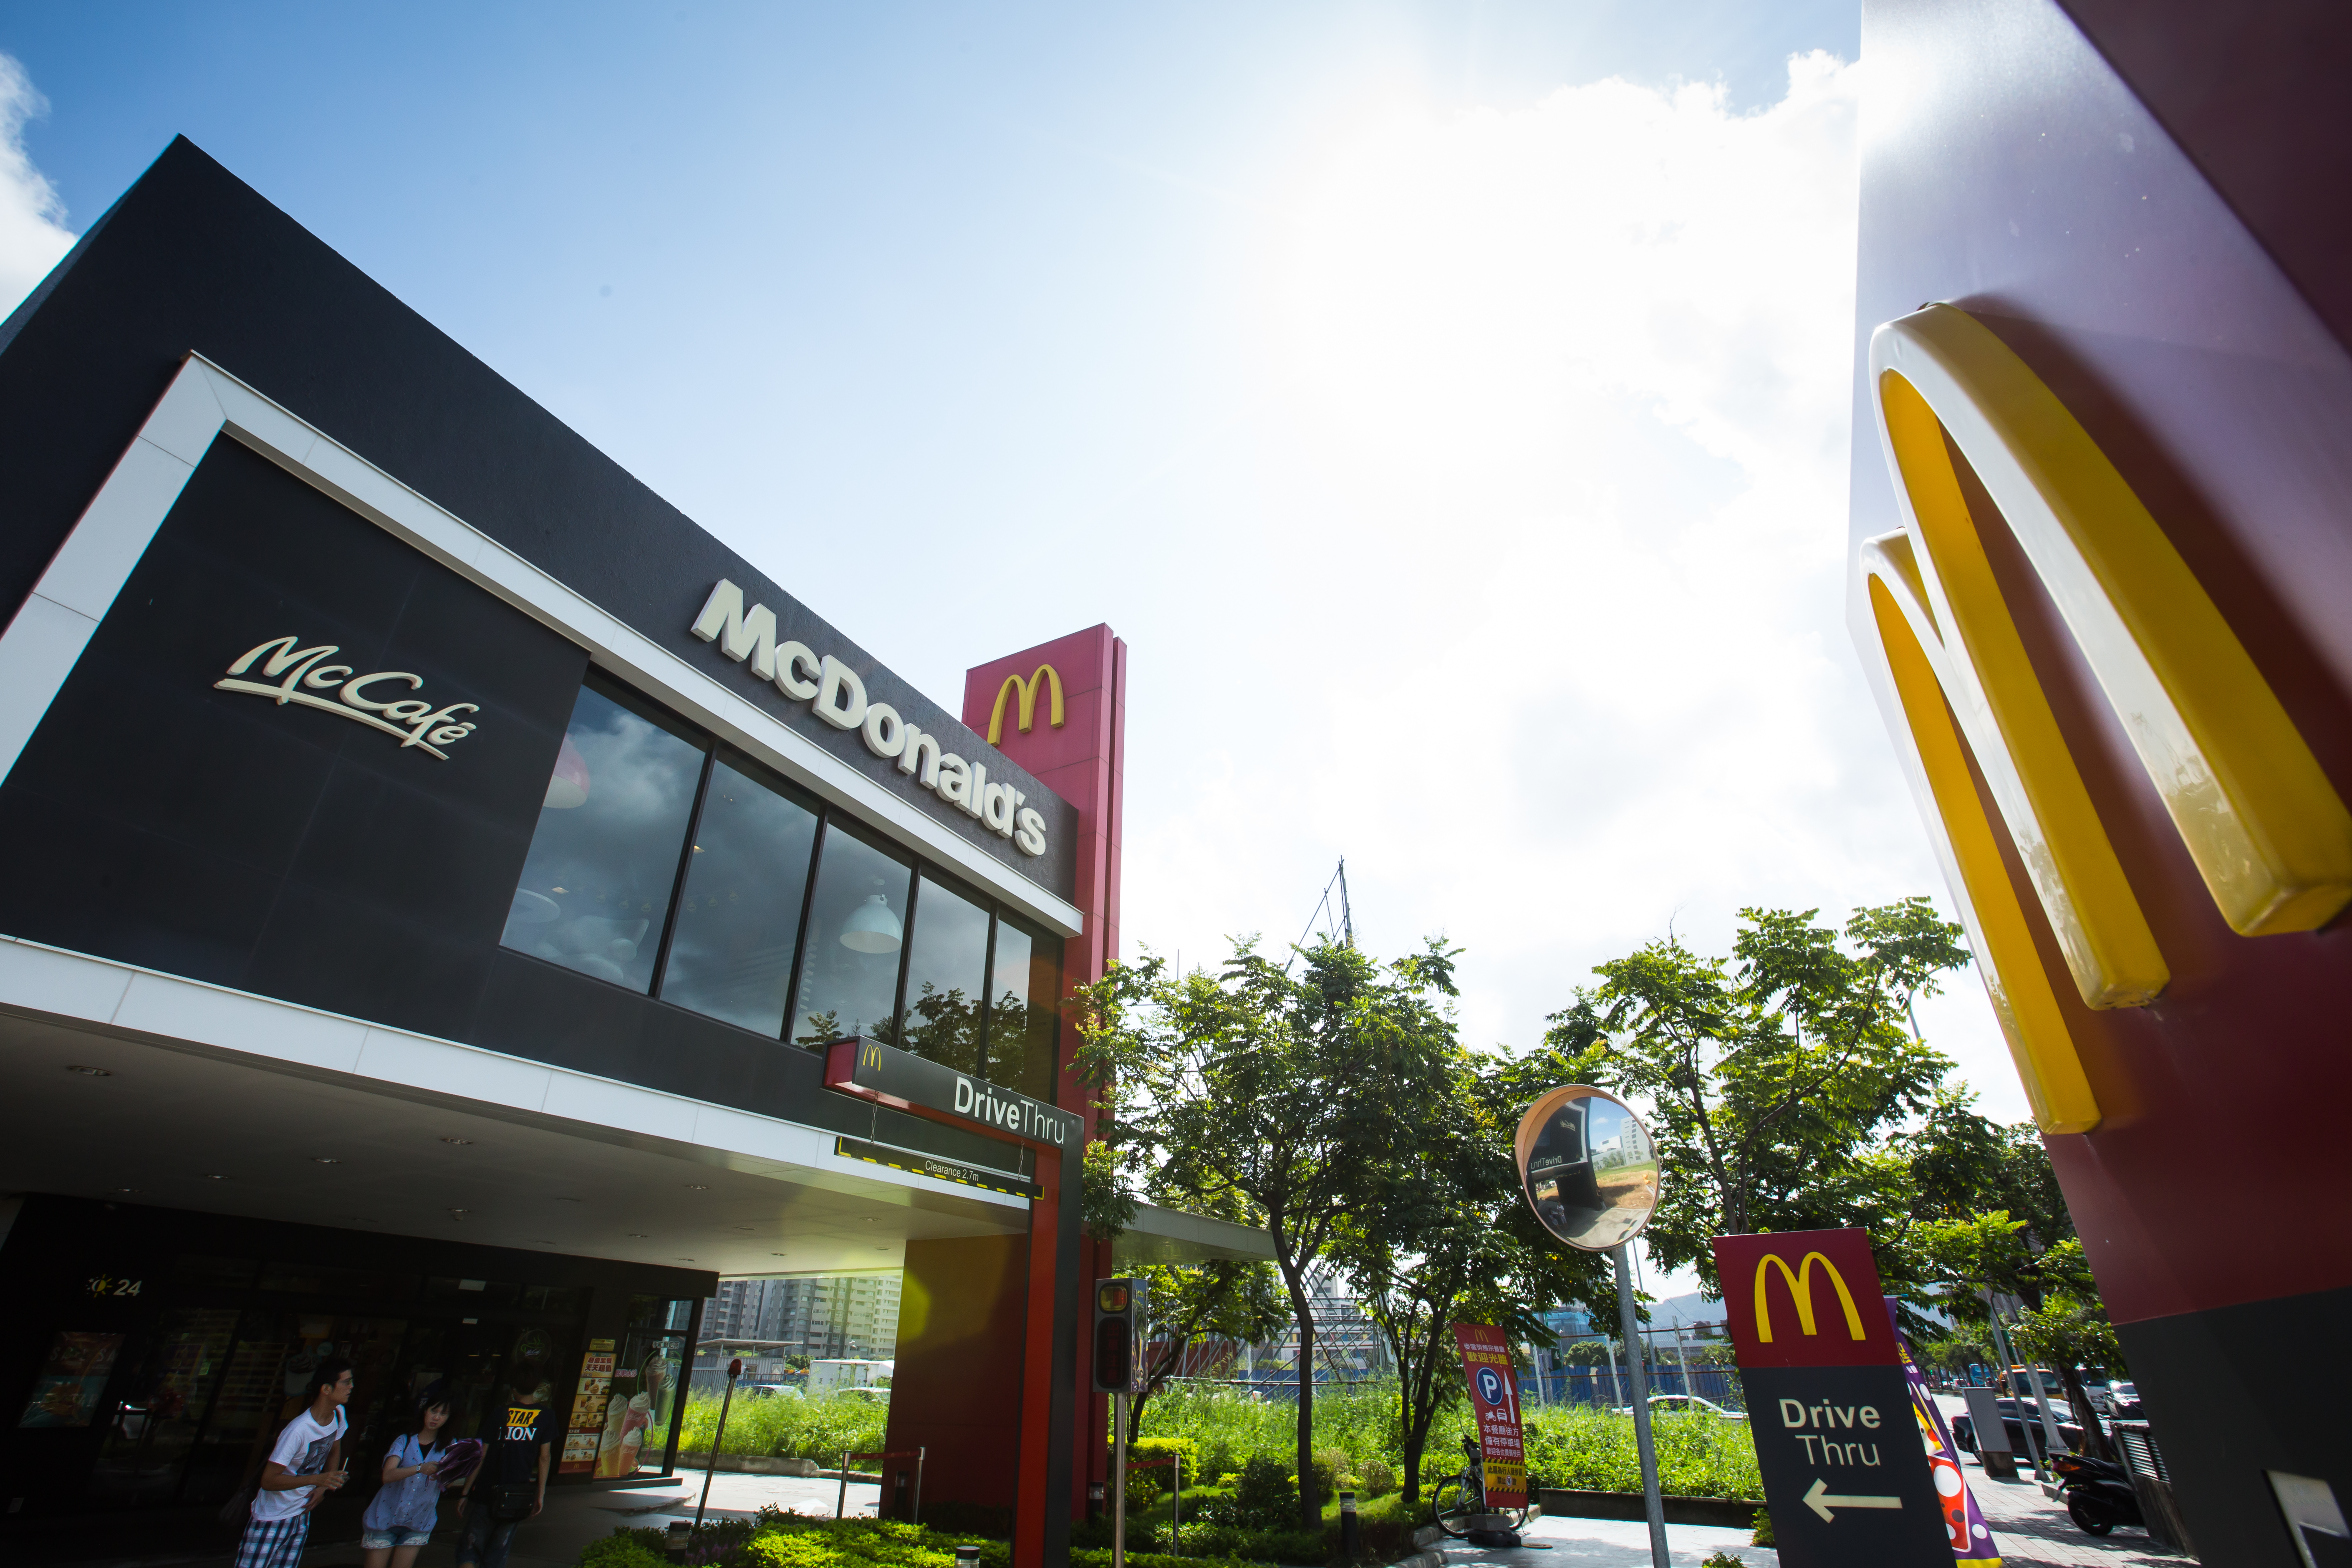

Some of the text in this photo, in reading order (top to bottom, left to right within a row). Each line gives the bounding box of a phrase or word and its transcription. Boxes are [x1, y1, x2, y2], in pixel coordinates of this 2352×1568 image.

[221, 636, 479, 751] McCafé
[691, 578, 1046, 857] McDonald's
[925, 1160, 979, 1182] Clearance 2.7m
[113, 1279, 143, 1296] 24
[1466, 1351, 1508, 1365] 歡迎光臨
[1484, 1375, 1496, 1399] P
[1779, 1398, 1880, 1428] Drive
[1483, 1424, 1519, 1437] 本餐廳後方
[1485, 1436, 1520, 1448] 備有停車場
[1486, 1447, 1521, 1457] 歡迎各位貴賓使用
[1795, 1434, 1880, 1466] Thru
